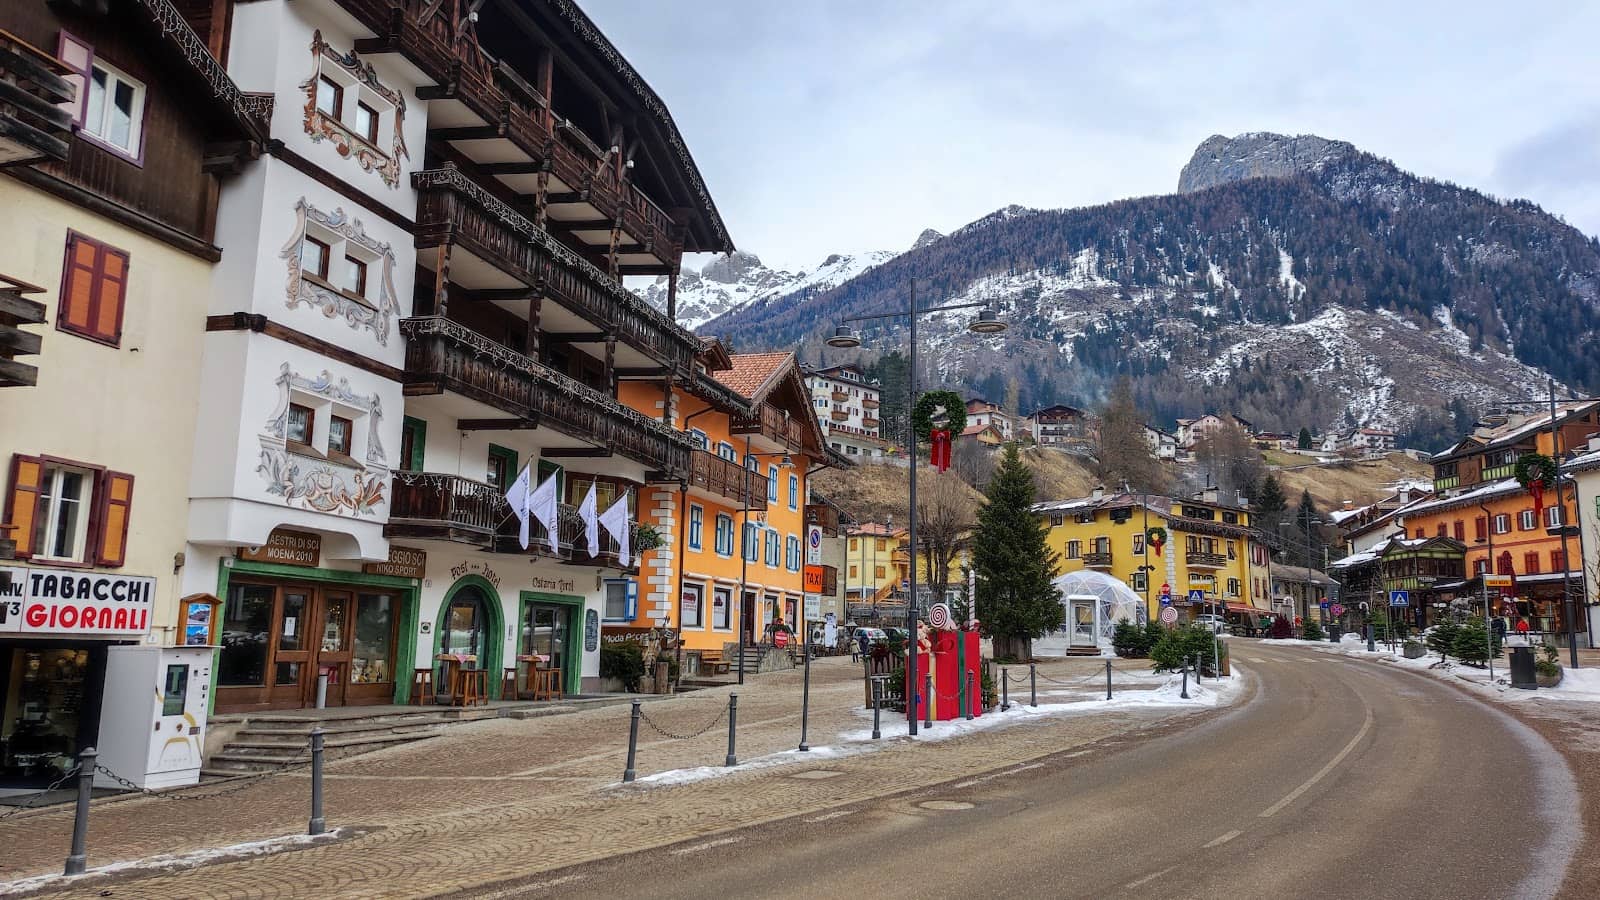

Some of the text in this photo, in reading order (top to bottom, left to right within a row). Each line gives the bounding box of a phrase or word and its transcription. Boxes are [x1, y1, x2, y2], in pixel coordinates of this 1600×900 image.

[268, 534, 319, 550] AESTRI DI SCI
[267, 548, 313, 562] MOENA 2010
[389, 550, 425, 567] GGIO SCI
[376, 563, 417, 577] NIKO SPORT
[806, 572, 822, 585] TAXI
[31, 574, 150, 602] TABACCHI
[26, 604, 147, 630] GIORNALI
